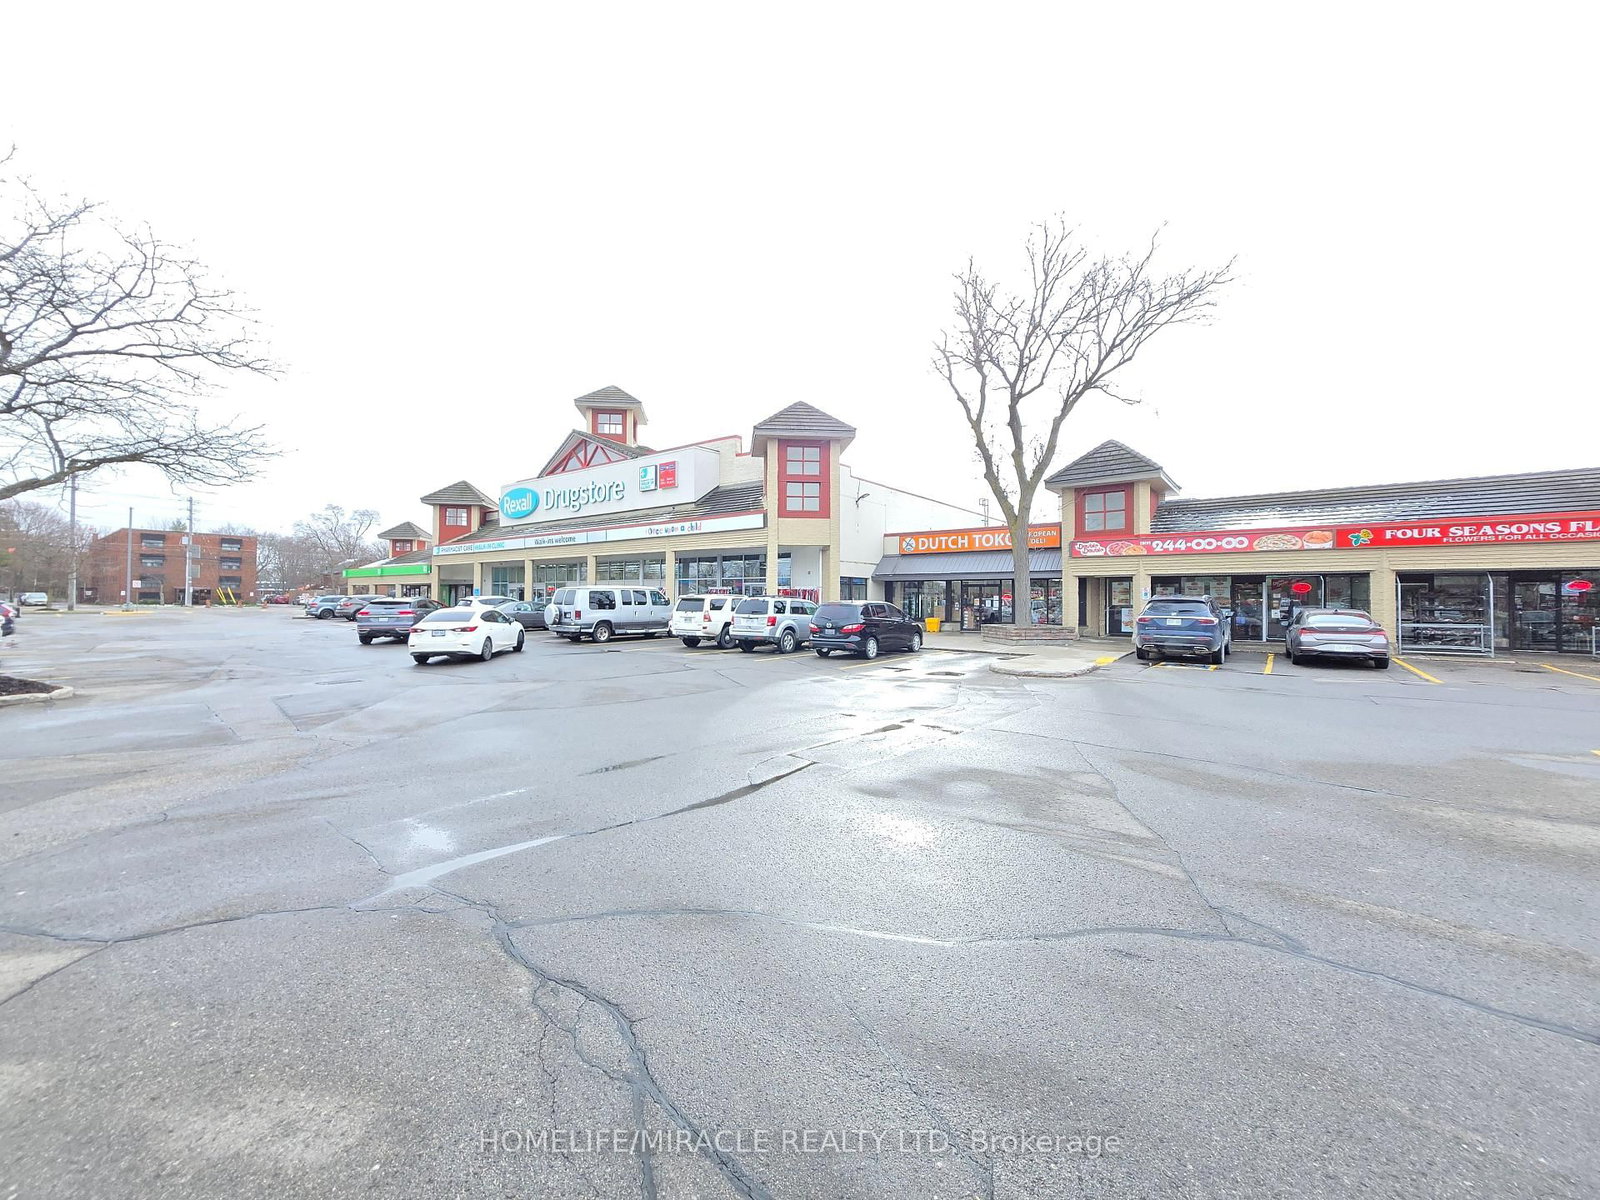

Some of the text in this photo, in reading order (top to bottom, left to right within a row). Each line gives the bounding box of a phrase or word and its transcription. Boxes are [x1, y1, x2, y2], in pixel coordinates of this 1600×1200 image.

[503, 492, 532, 514] Rexall
[543, 479, 625, 512] Drugstore
[1385, 527, 1440, 539] FOUR
[1448, 521, 1561, 538] SEASONS
[1443, 535, 1495, 543] FLOWERS
[918, 535, 968, 550] DUTCH
